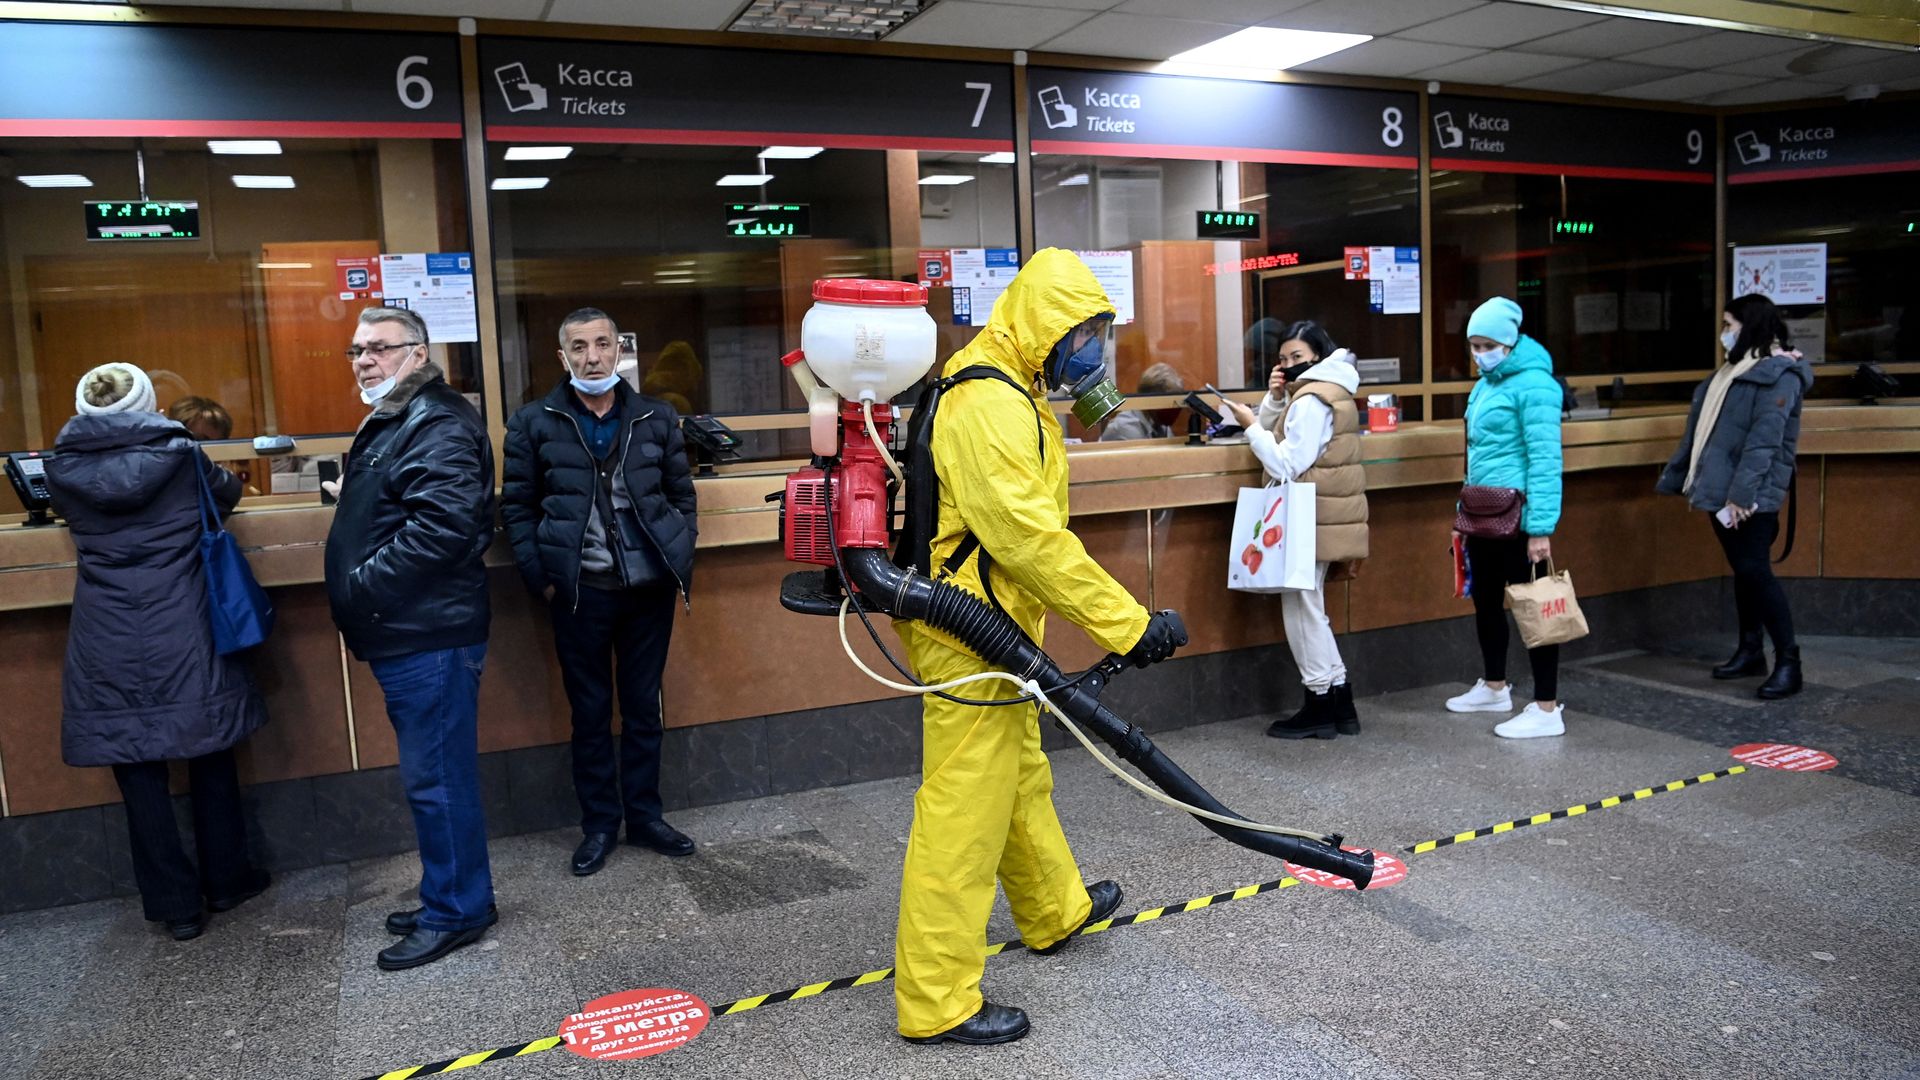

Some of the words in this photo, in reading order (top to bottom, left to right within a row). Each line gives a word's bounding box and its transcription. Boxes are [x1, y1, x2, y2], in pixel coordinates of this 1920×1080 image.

[397, 55, 434, 110] 6
[558, 63, 633, 87] Касса
[561, 97, 626, 116] Tickets
[965, 82, 992, 128] 7
[1085, 87, 1141, 109] Касса
[1086, 116, 1136, 133] Tickets
[1382, 106, 1404, 148] 8
[1468, 112, 1510, 132] Касса
[1779, 127, 1835, 143] Касса
[1469, 137, 1506, 153] Tickets
[1686, 129, 1703, 165] 9
[1779, 149, 1828, 162] Tickets
[565, 1013, 632, 1031] соблюдайте
[634, 1000, 693, 1018] дистанцию
[570, 993, 690, 1022] Пожалуйста,
[562, 1025, 606, 1045] 1,5
[614, 1007, 704, 1035] метра
[591, 1037, 625, 1053] друг
[628, 1033, 645, 1043] от
[648, 1024, 690, 1041] друга
